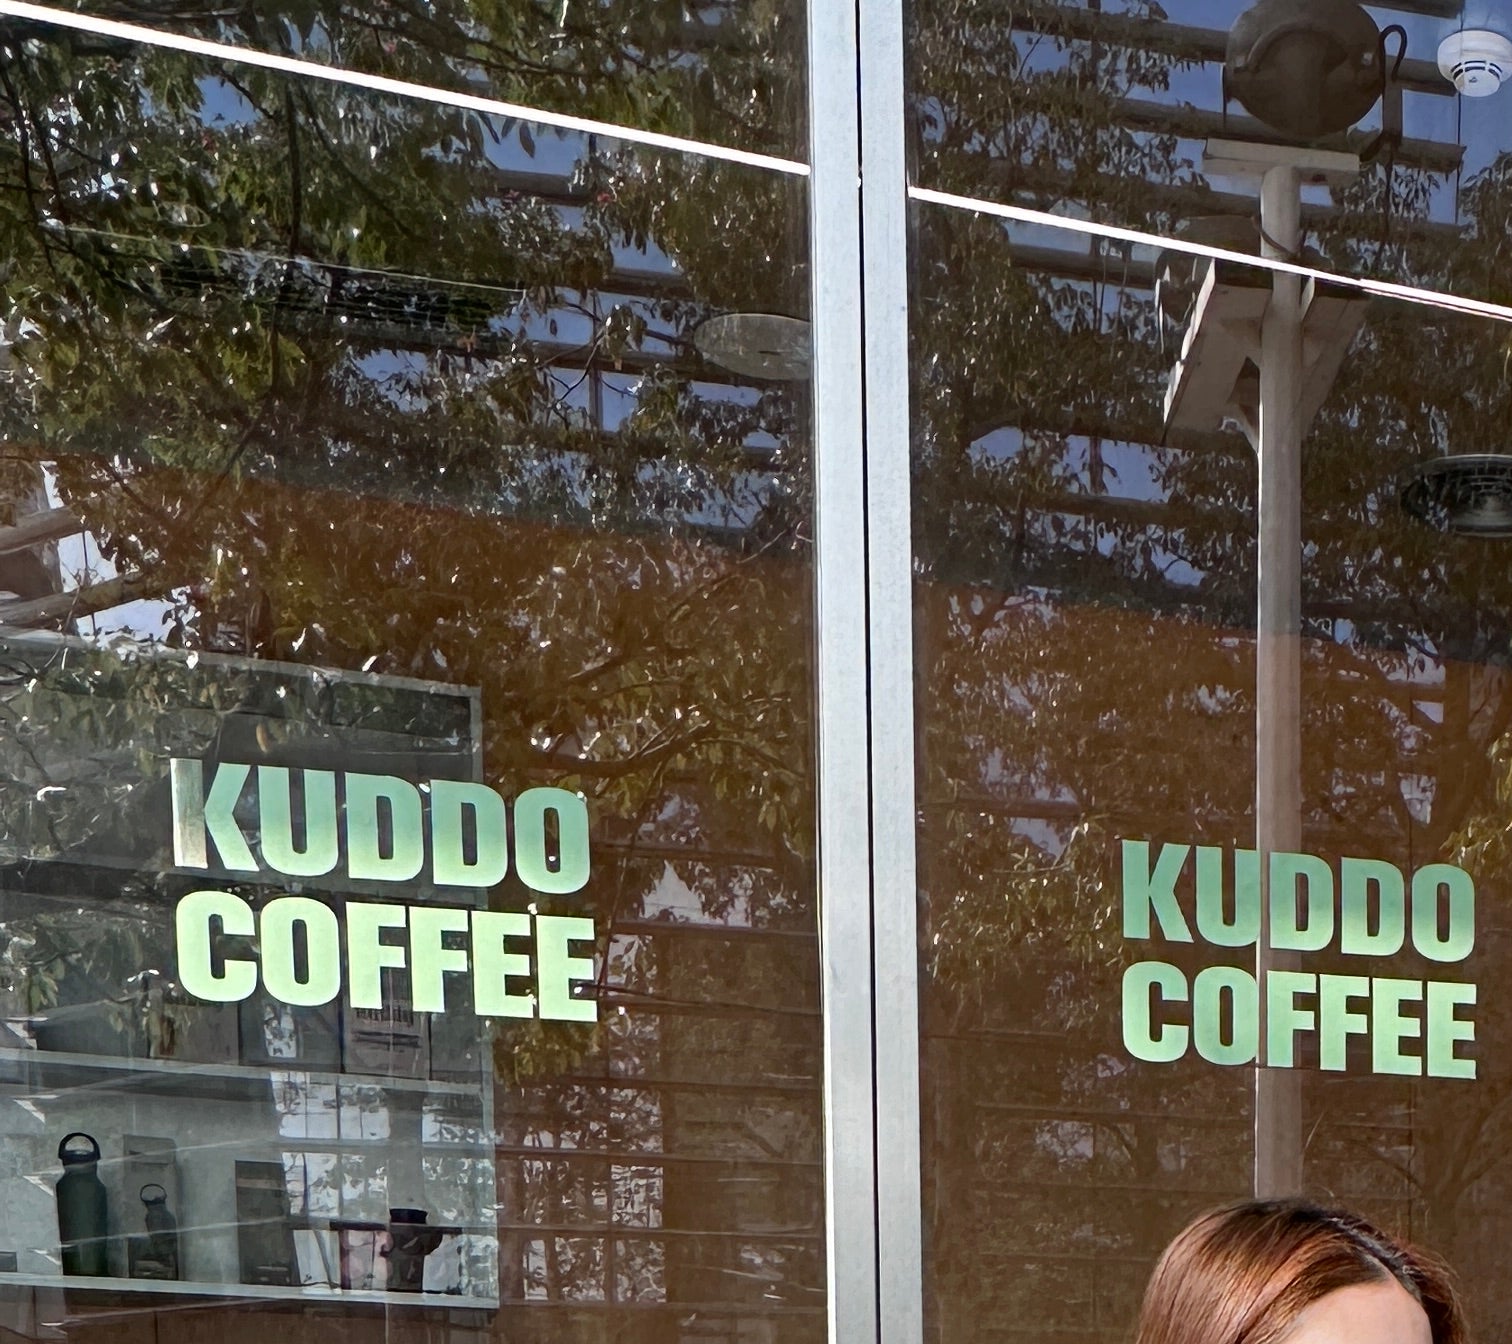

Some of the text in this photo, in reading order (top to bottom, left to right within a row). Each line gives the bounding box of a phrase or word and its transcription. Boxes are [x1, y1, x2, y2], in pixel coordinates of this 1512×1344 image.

[170, 758, 590, 894] KUDDO
[176, 890, 598, 1022] COFFEE
[1122, 839, 1475, 962] KUDDO
[1122, 961, 1477, 1079] COFFEE
